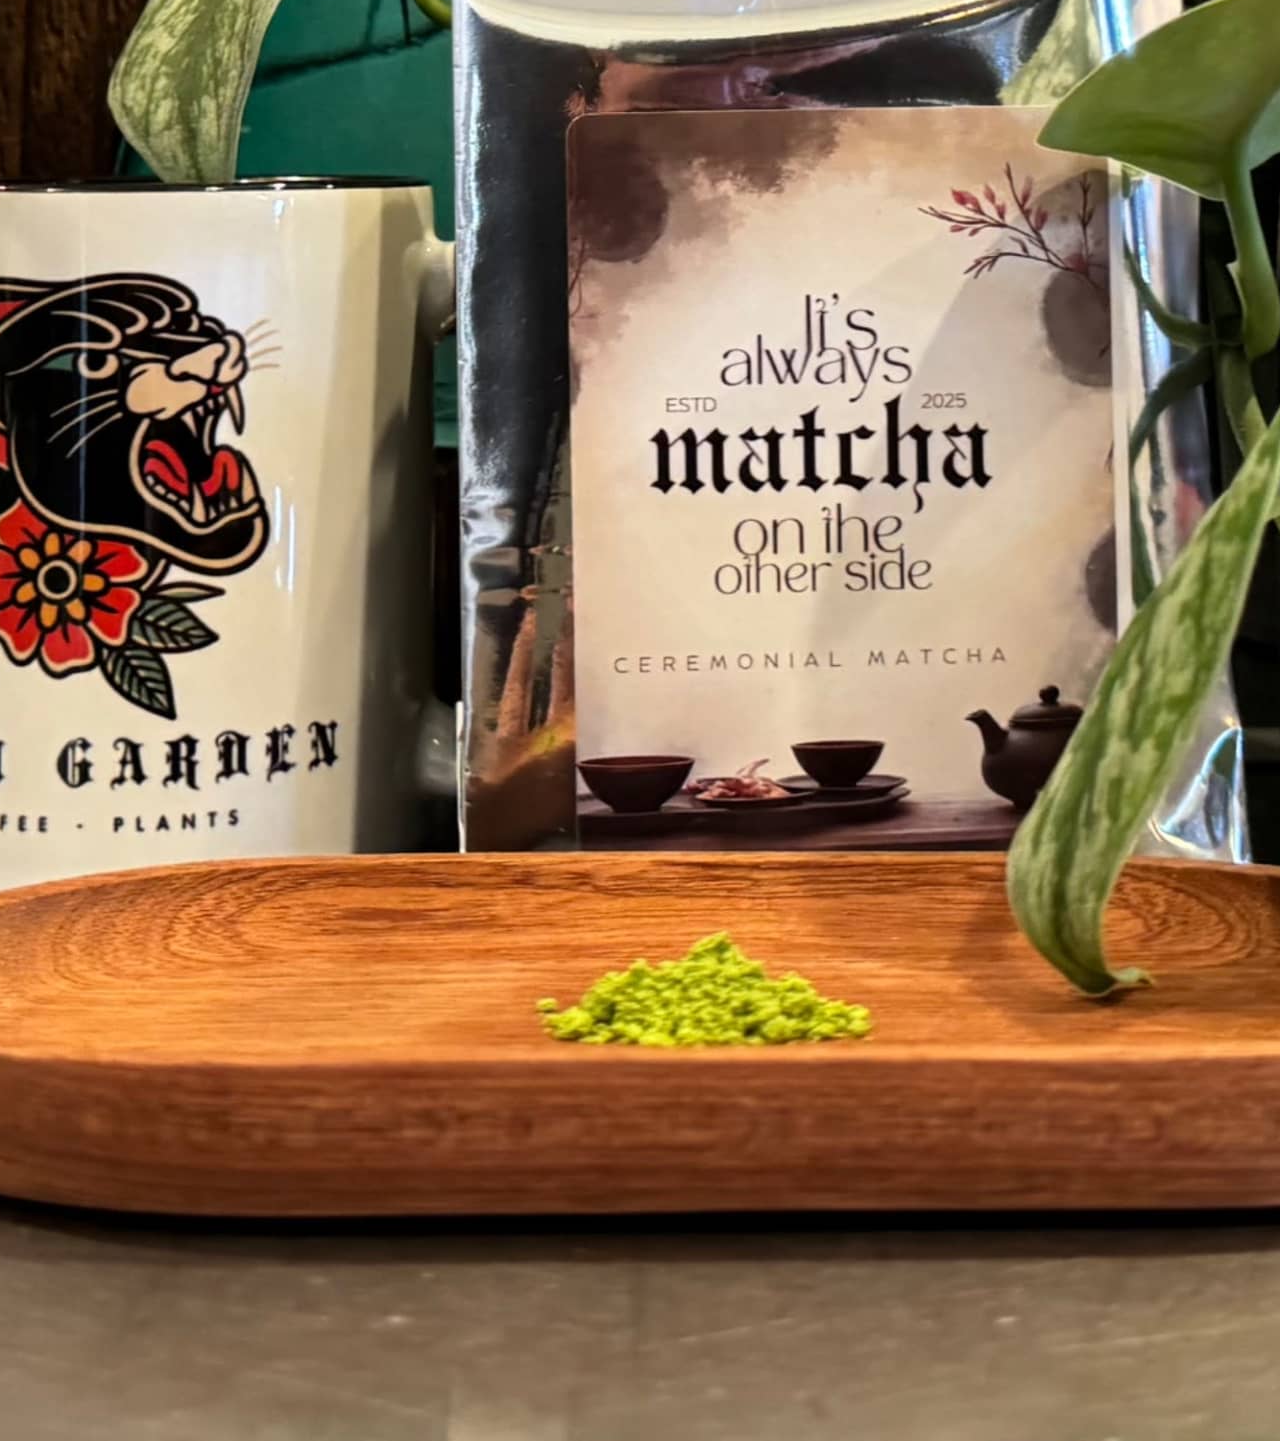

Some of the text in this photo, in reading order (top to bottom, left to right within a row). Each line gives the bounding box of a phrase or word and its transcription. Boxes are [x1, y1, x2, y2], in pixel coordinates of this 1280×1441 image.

[720, 334, 912, 403] always
[665, 397, 717, 413] ESTD
[921, 393, 967, 409] 2025
[649, 394, 993, 514] matcha
[733, 503, 905, 557] on the
[714, 548, 933, 595] other side
[613, 647, 1008, 674] CEREMONIAL MATCHA
[57, 720, 339, 790] GARDEN
[113, 808, 240, 833] PLANTS
